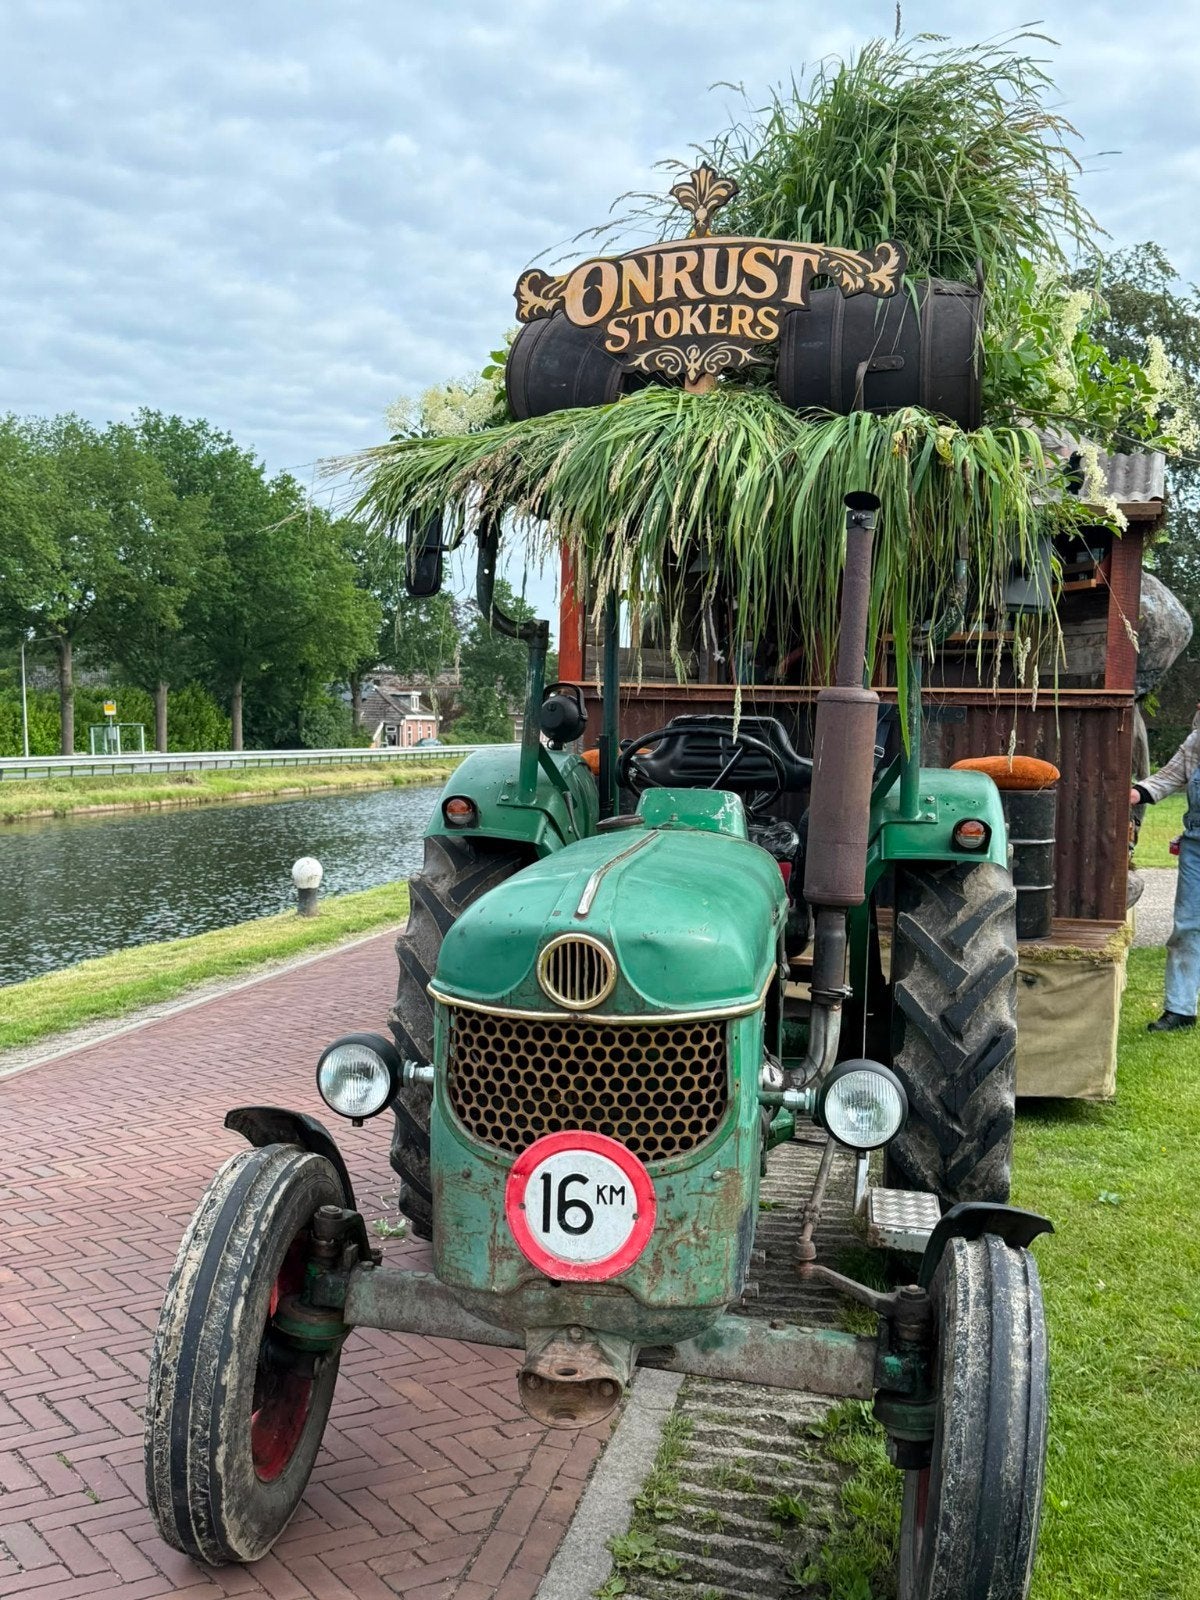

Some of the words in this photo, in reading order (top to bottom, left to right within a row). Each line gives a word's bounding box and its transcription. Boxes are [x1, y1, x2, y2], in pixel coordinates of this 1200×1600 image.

[563, 246, 820, 327] ONRUST
[604, 303, 780, 352] STOKERS
[541, 1172, 594, 1235] 16
[596, 1184, 626, 1205] KM
